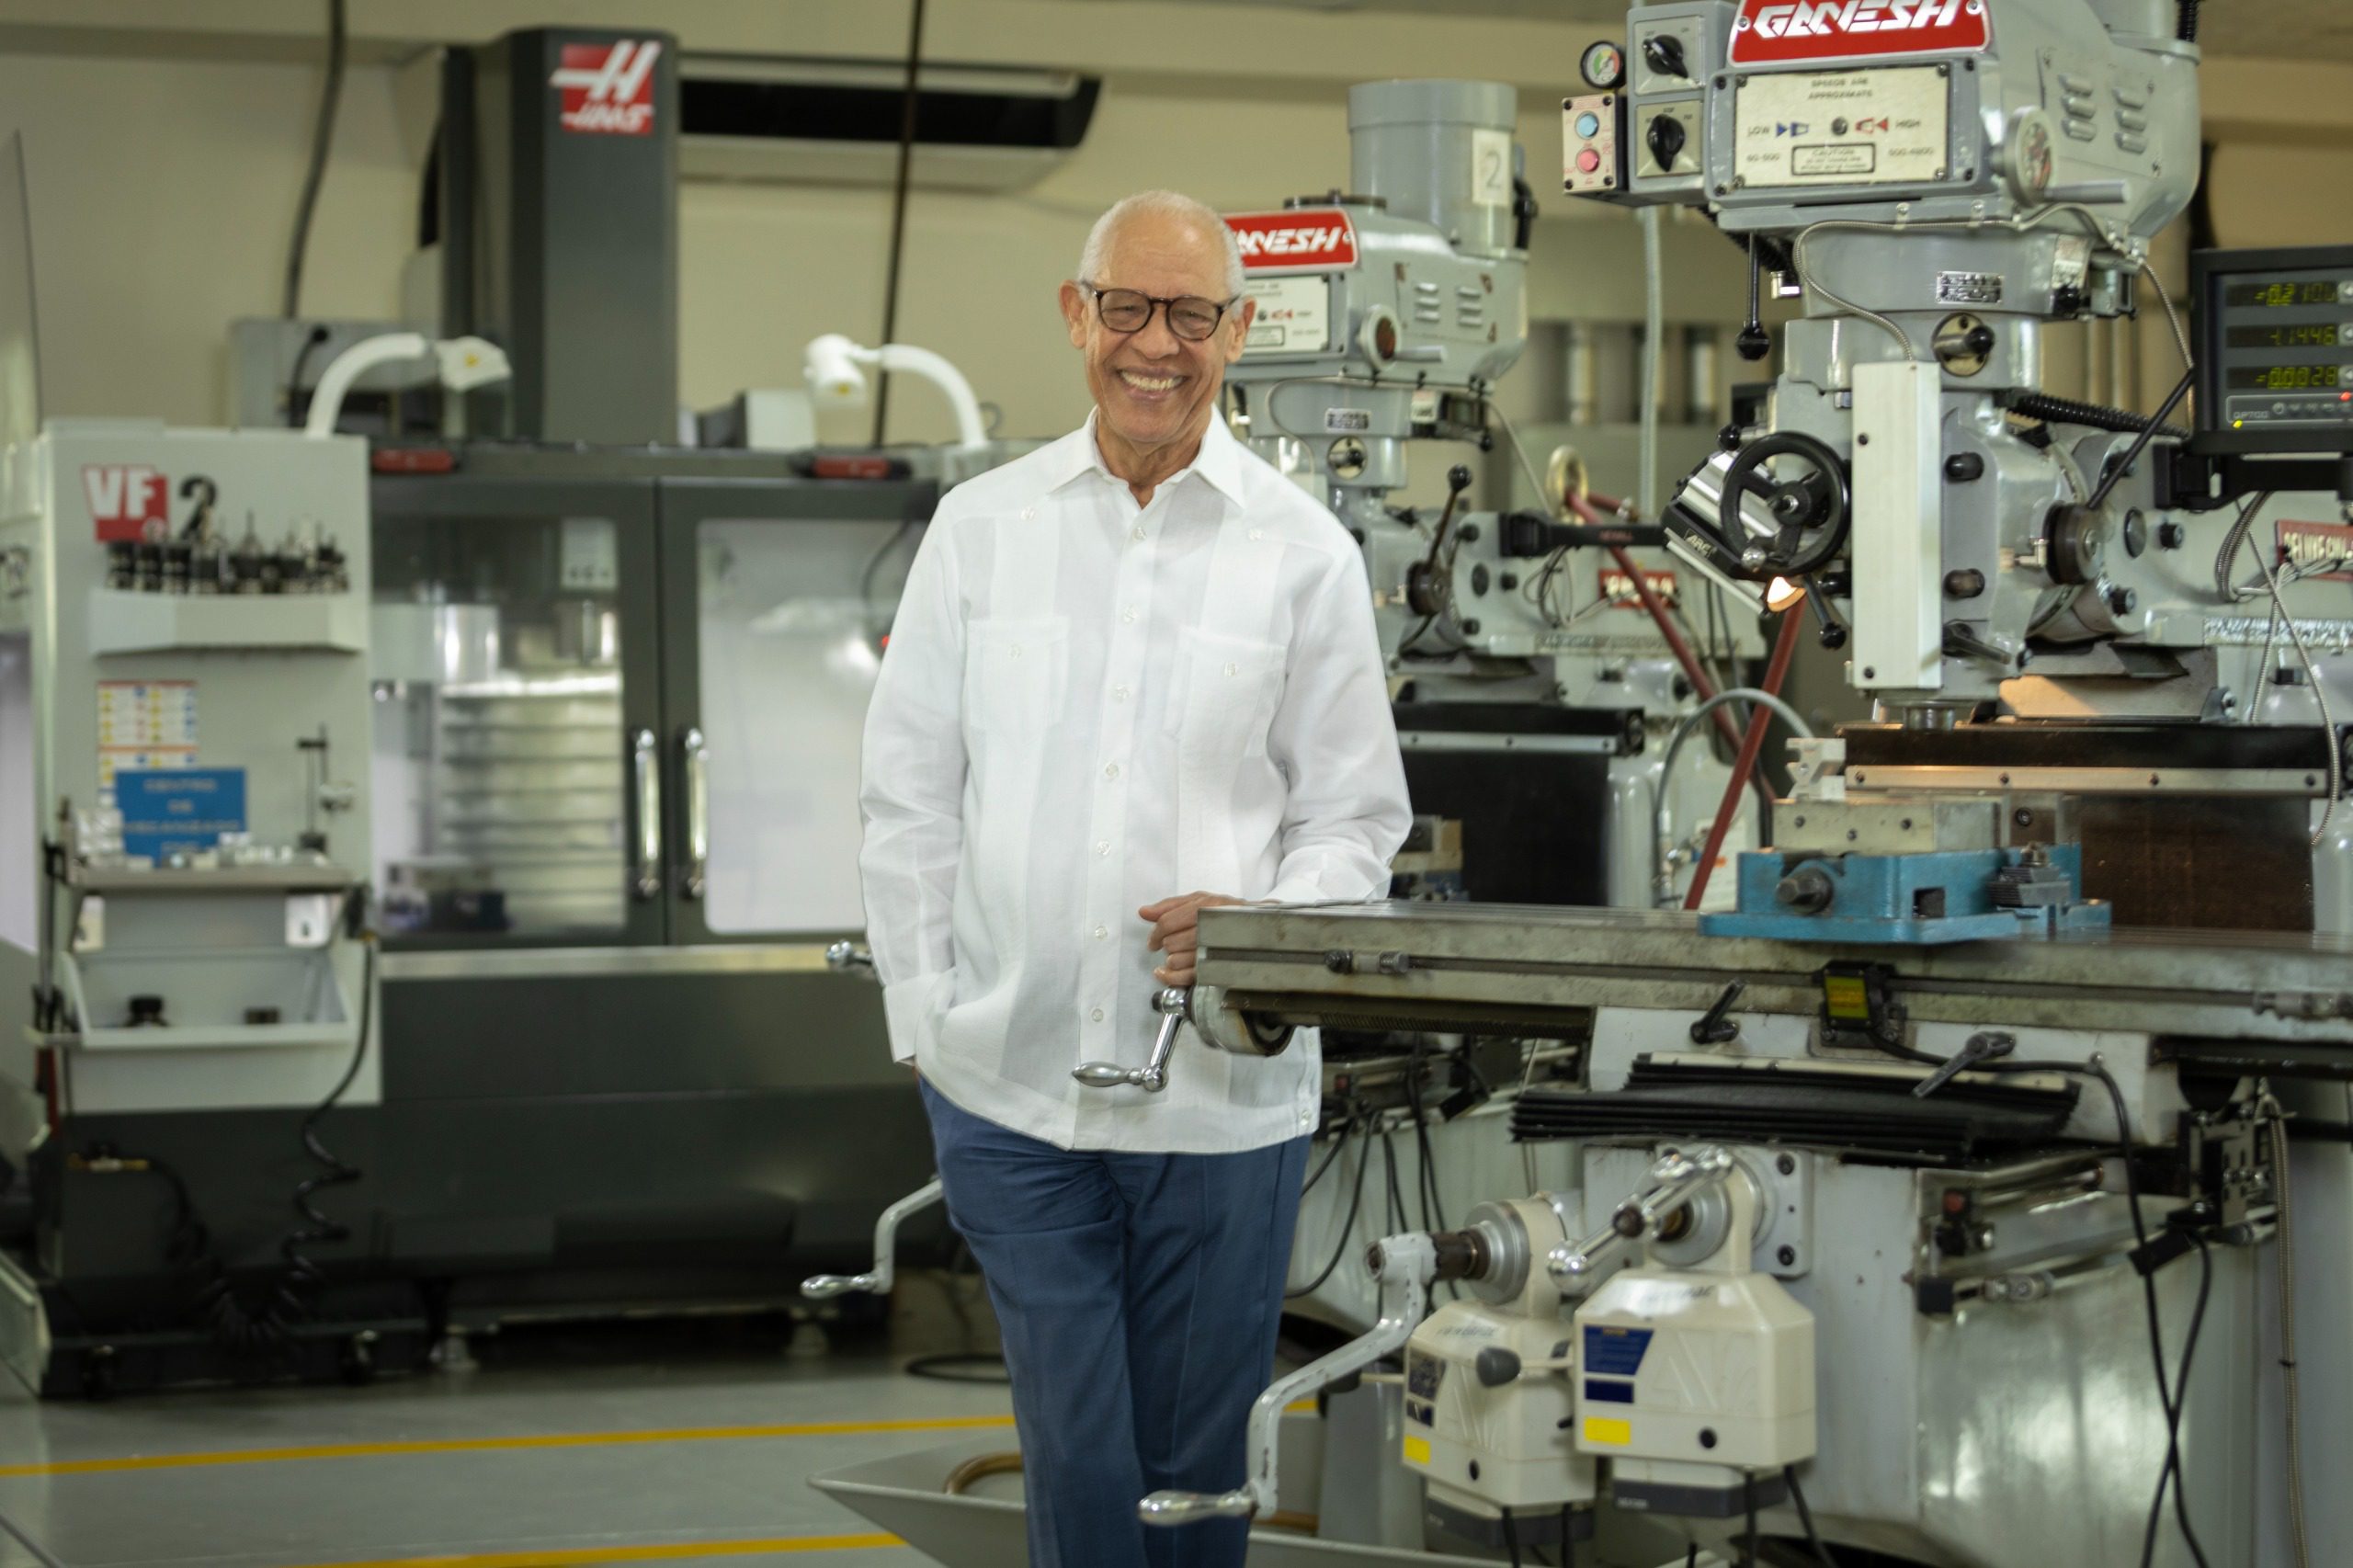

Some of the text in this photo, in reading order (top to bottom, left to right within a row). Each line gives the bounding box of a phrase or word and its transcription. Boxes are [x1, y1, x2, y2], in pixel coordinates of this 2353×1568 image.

[1753, 0, 1962, 39] GANESH
[1807, 90, 1873, 100] APPROXIMATE
[1748, 126, 1770, 137] LOW
[1894, 119, 1921, 130] HIGH
[1485, 150, 1502, 188] 2
[1233, 227, 1342, 256] ANESH
[85, 468, 156, 520] VF
